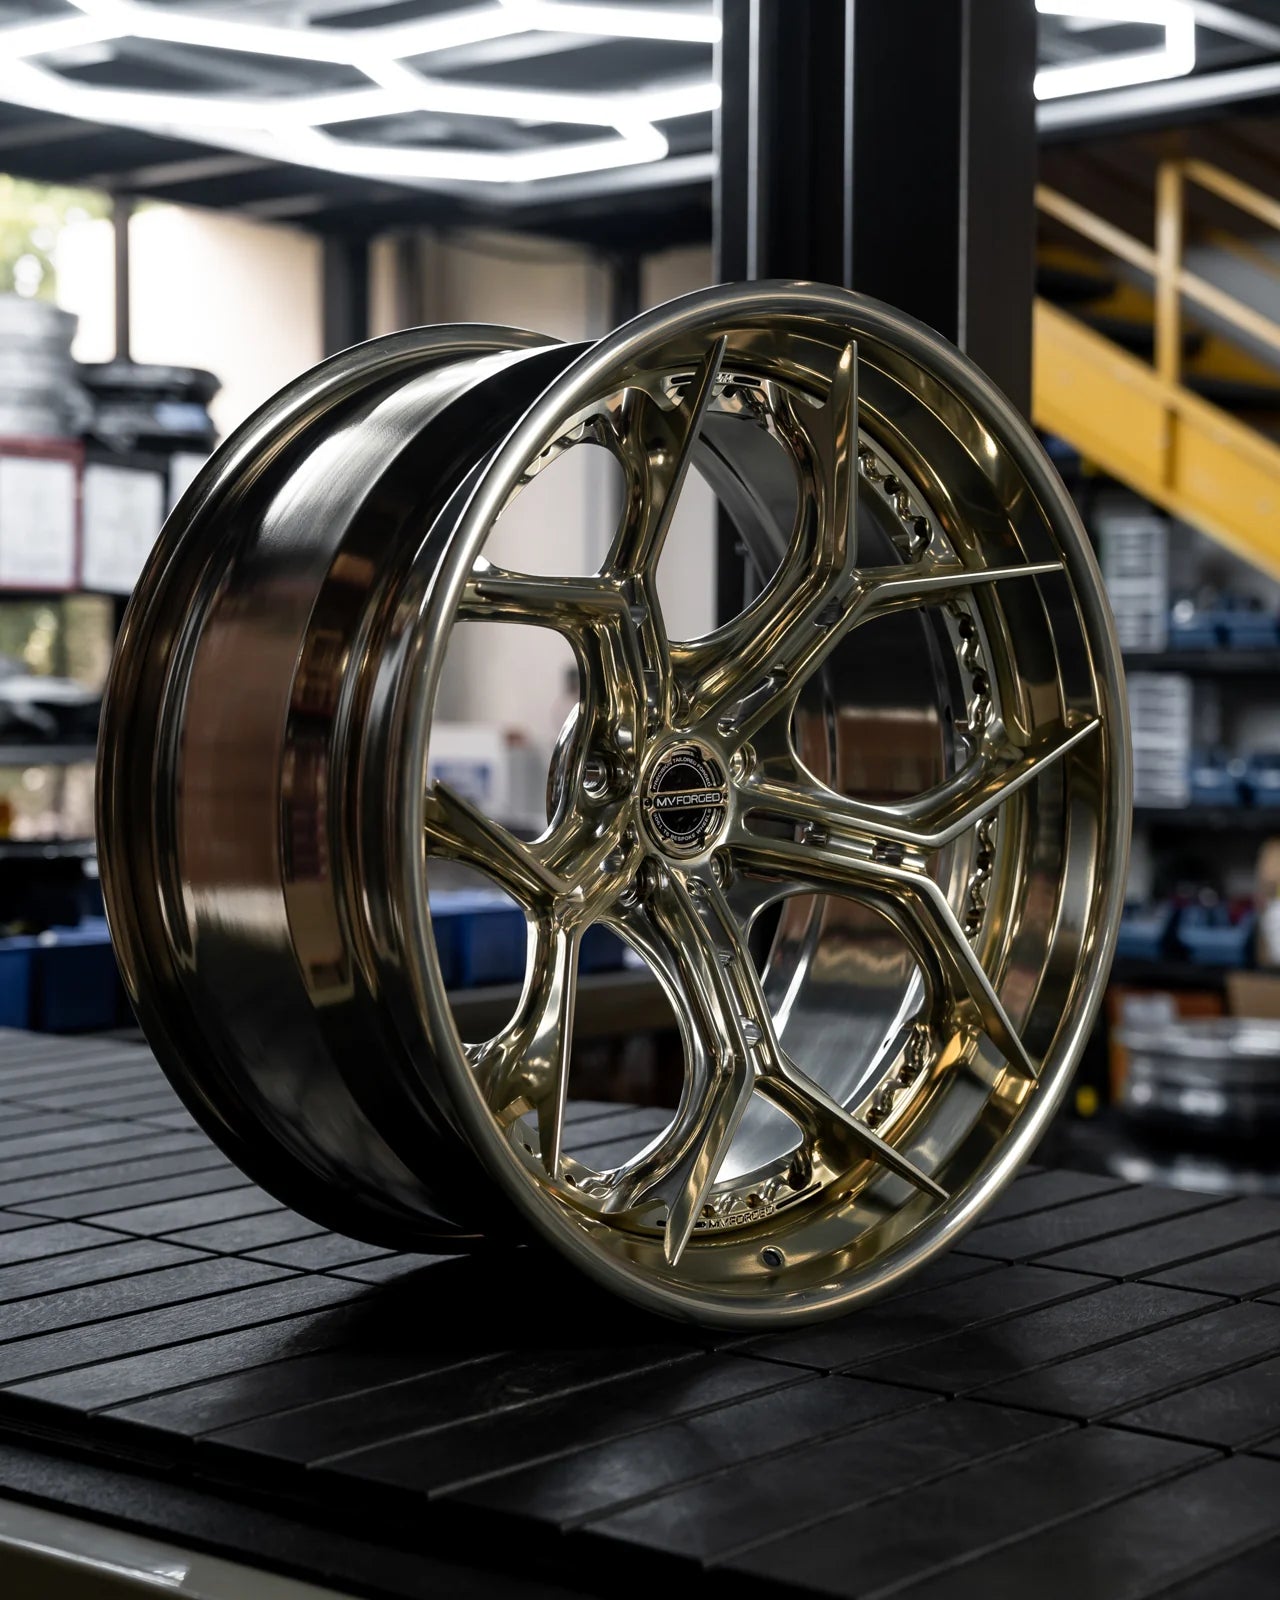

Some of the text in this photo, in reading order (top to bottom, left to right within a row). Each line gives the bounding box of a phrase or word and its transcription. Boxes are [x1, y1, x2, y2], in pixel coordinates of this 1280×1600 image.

[672, 757, 697, 767] TAILORED
[696, 763, 712, 787] FORGED
[656, 792, 720, 807] MVFORGED
[670, 832, 696, 842] BESPOKE
[709, 1206, 774, 1228] MVFORGED
